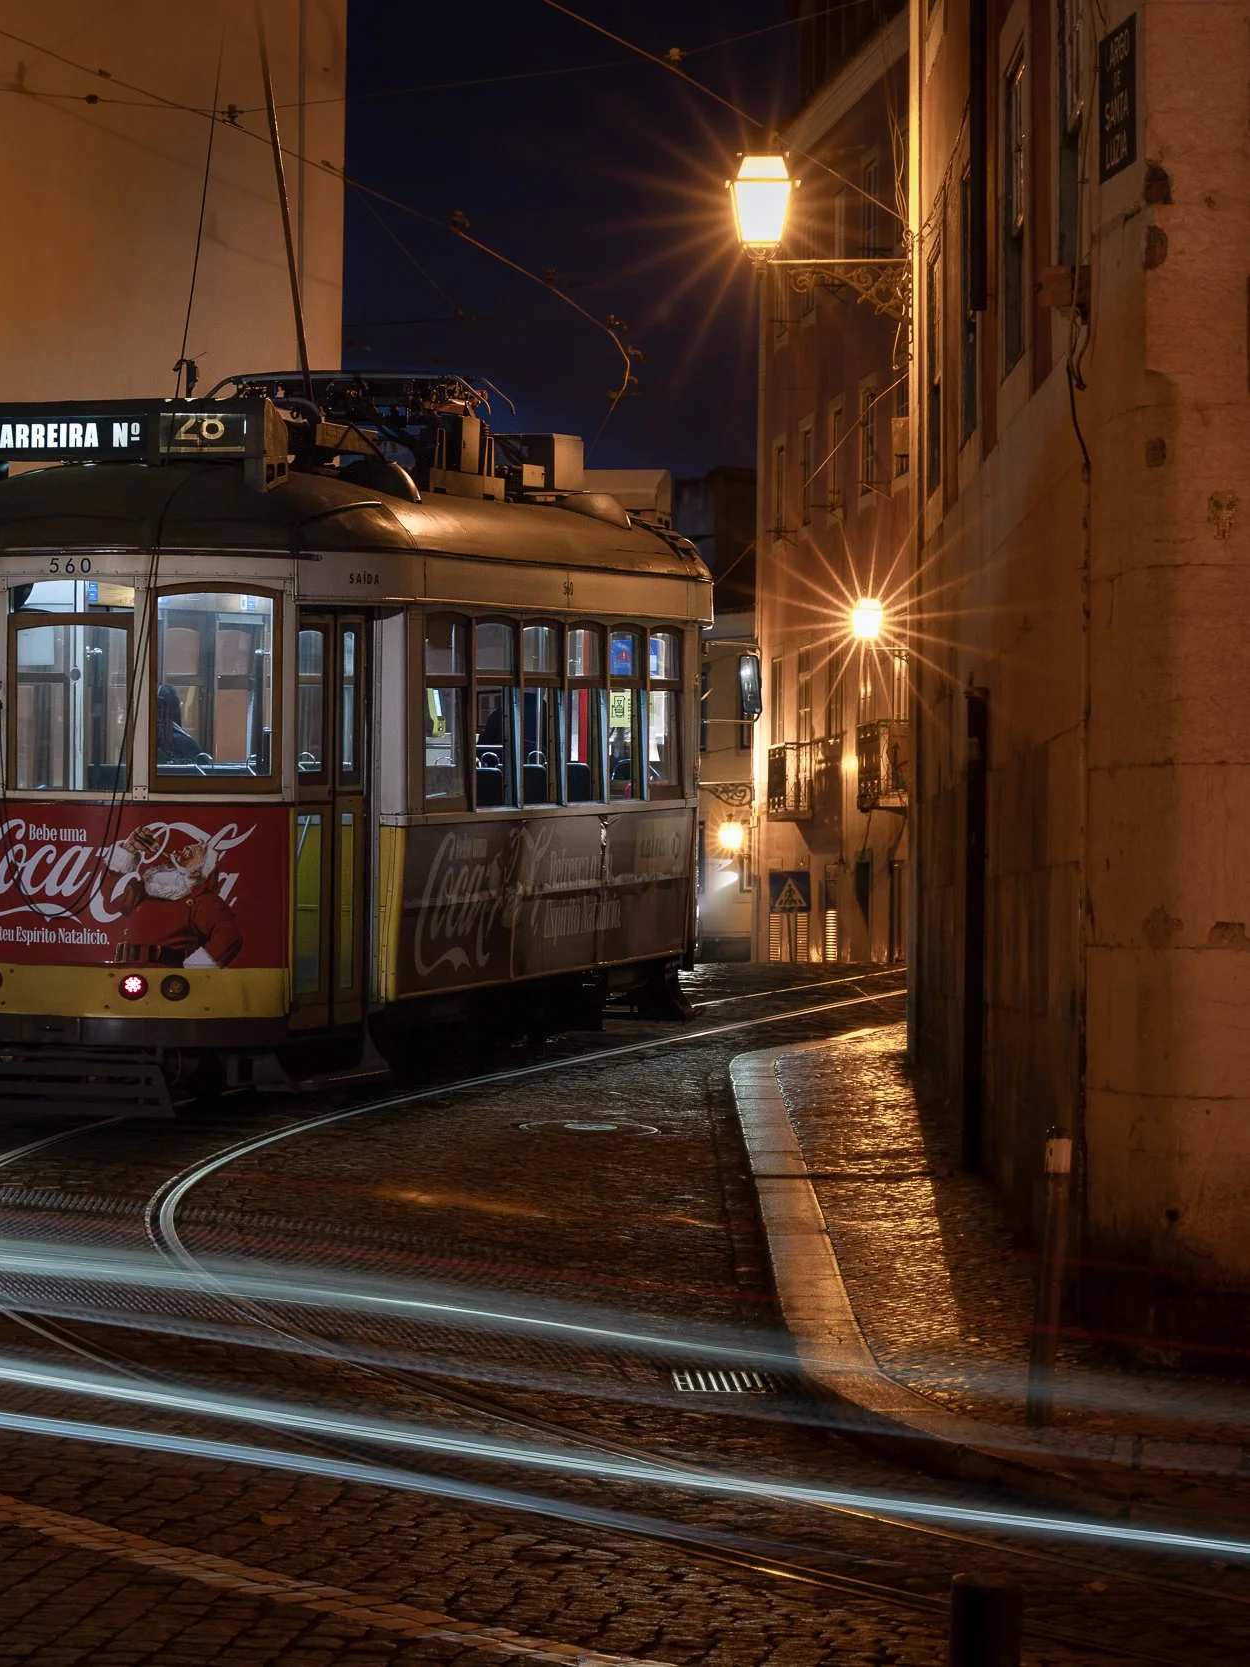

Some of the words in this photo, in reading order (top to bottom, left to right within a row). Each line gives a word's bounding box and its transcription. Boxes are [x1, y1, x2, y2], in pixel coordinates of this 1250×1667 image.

[1105, 88, 1130, 132] SANTA
[1105, 129, 1128, 170] LUZIA
[112, 422, 141, 448] Nº
[174, 413, 225, 441] 28
[49, 558, 92, 574] 560
[349, 571, 380, 585] SAÍDA
[28, 823, 58, 842] Bebe
[59, 825, 87, 842] uma
[0, 926, 15, 942] teu
[16, 926, 57, 946] Espírito
[58, 927, 110, 945] Natalício.
